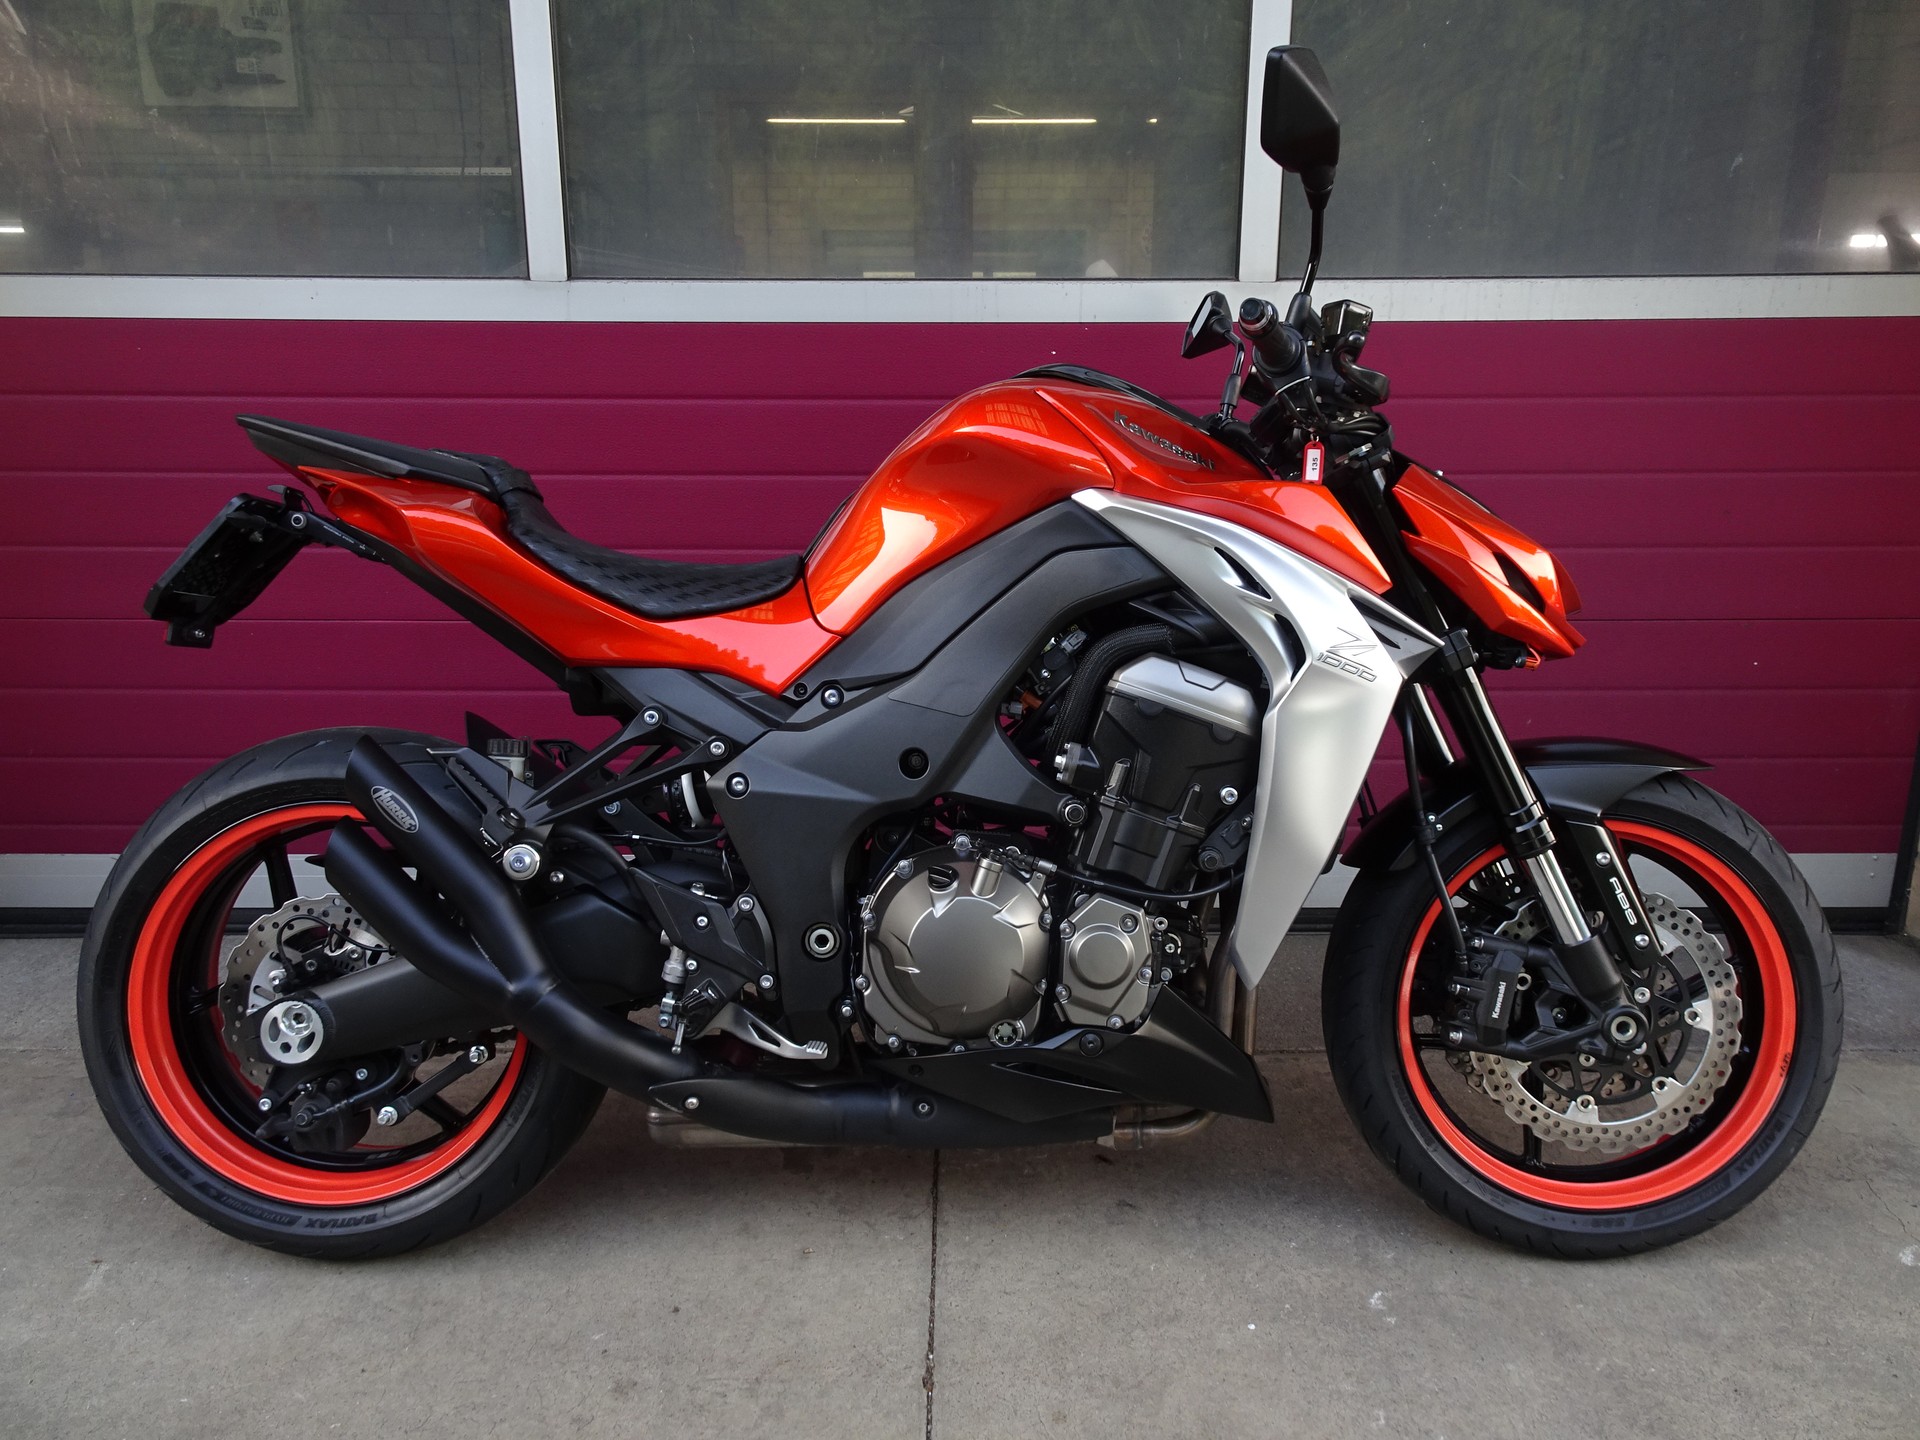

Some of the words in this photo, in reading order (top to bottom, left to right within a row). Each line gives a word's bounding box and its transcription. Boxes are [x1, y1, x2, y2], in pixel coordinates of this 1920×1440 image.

[1114, 409, 1215, 471] Kawasaki
[1311, 457, 1319, 471] 135
[1317, 651, 1377, 682] 1000
[1609, 876, 1637, 926] ABS
[1491, 981, 1507, 1019] Kawasaki
